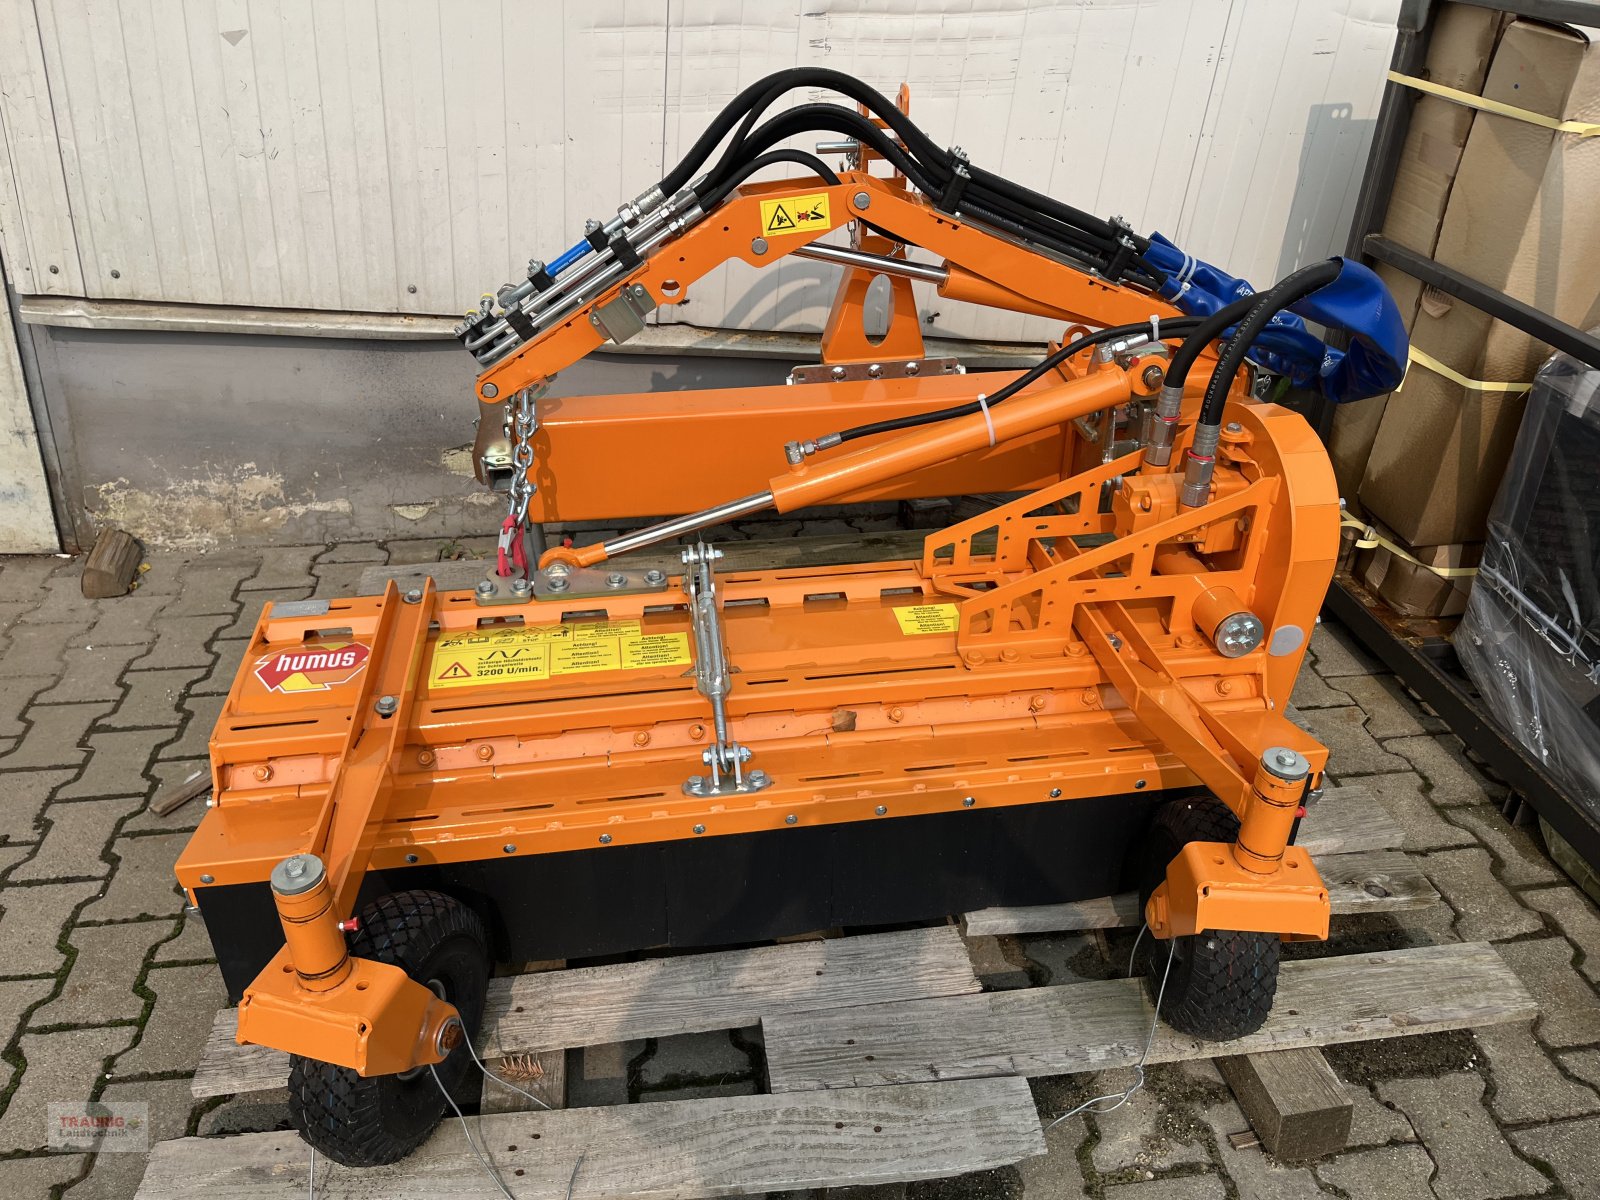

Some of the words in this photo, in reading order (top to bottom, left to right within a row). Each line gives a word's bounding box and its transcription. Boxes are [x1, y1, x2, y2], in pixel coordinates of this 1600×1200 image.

[1227, 331, 1241, 351] PLUS
[275, 652, 356, 672] humus
[476, 668, 503, 677] 3200
[507, 665, 542, 674] U/min.
